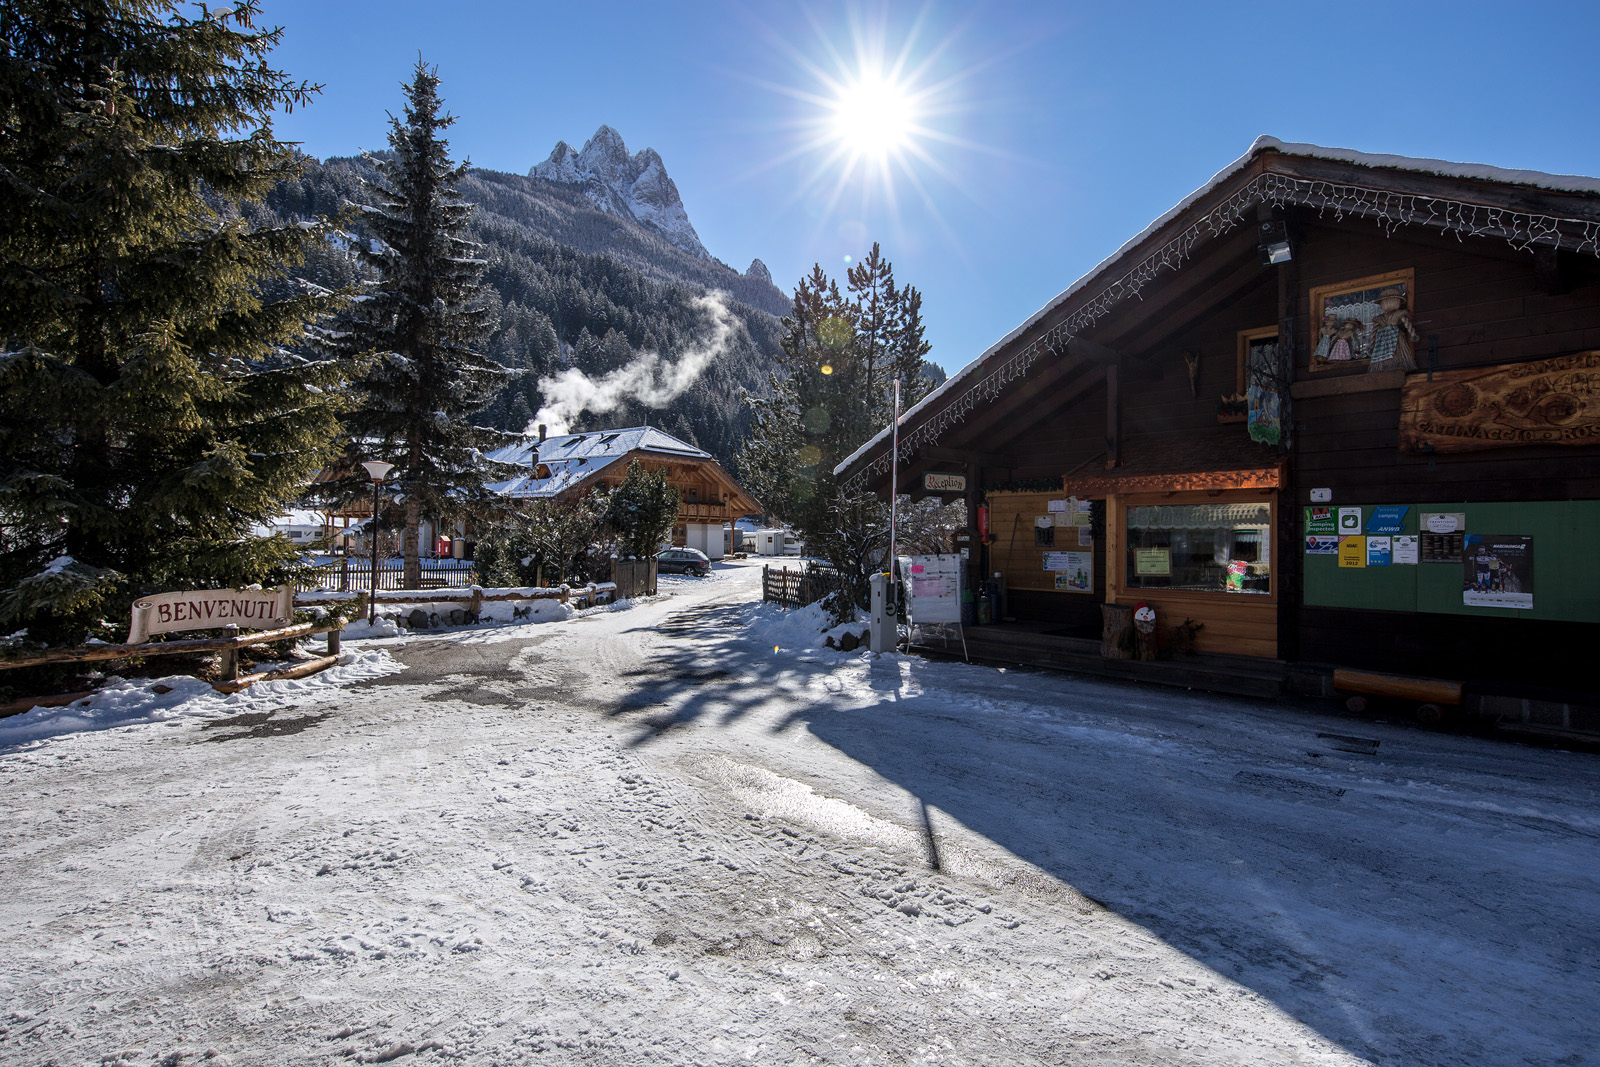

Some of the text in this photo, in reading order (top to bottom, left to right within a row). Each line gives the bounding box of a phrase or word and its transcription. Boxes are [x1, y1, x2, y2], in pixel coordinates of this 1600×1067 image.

[1415, 421, 1536, 441] CATINACCIO
[926, 474, 963, 490] Reception
[157, 599, 275, 624] BENVENUTI
